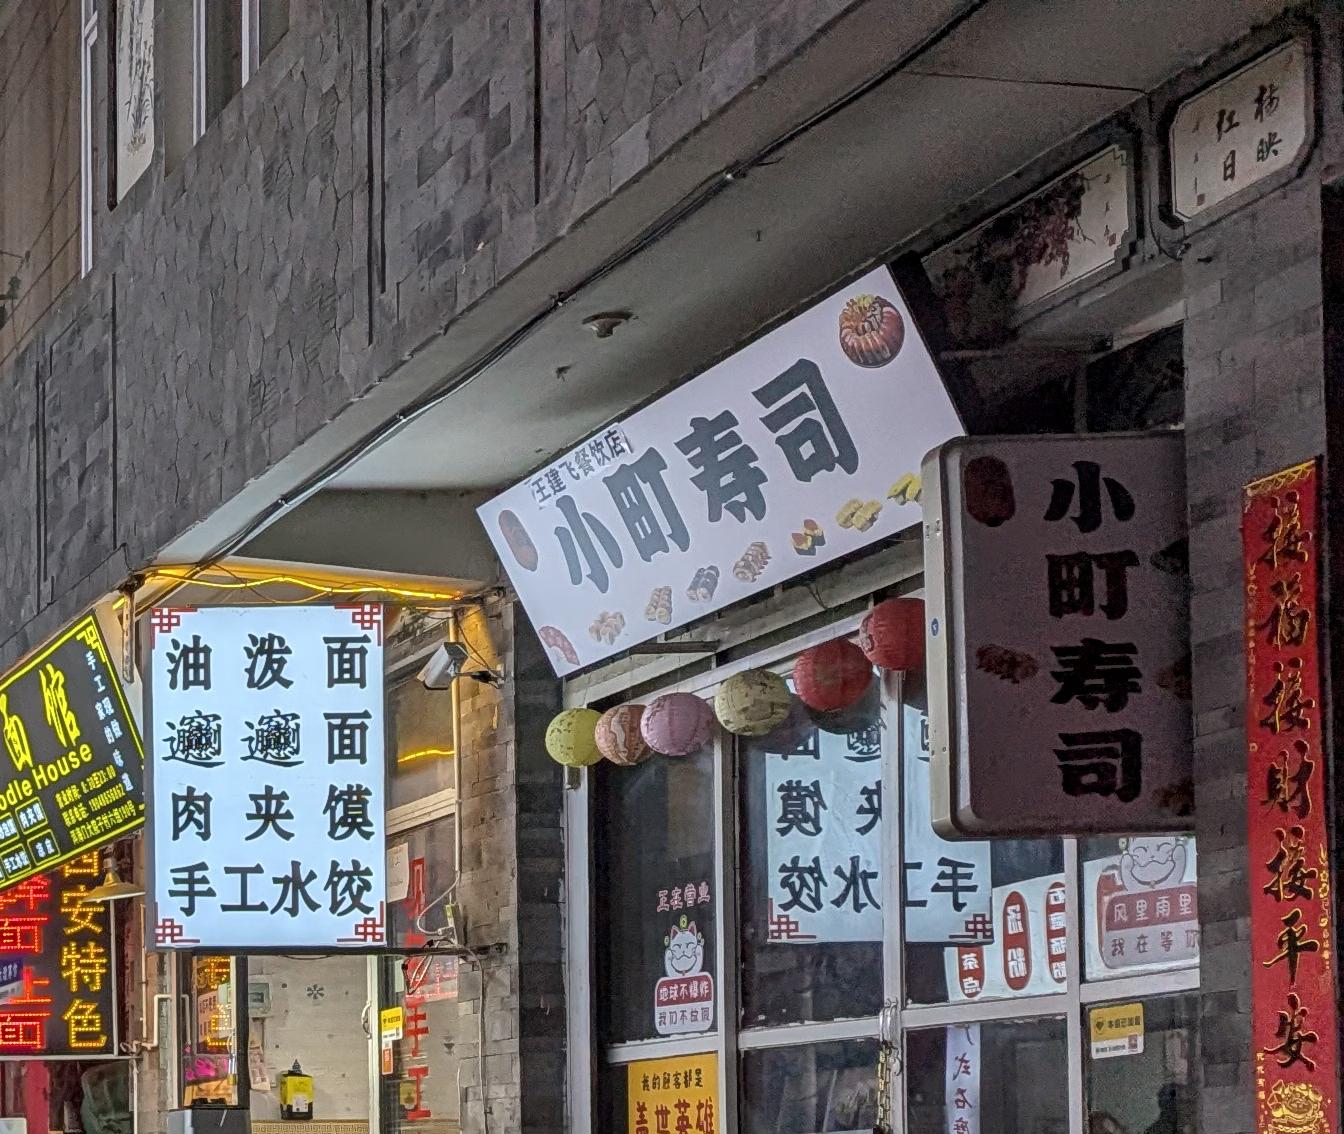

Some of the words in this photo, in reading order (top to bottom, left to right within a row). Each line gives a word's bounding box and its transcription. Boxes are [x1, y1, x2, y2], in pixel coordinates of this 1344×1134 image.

[553, 358, 858, 594] 小町寿司
[1043, 461, 1143, 802] 小町寿司
[166, 633, 372, 690] 油泼面
[32, 744, 93, 790] House
[170, 784, 375, 841] 肉夹馍
[169, 859, 374, 917] 手工水饺
[657, 881, 710, 912] 正在营业
[1114, 893, 1192, 922] 风里雨里
[61, 850, 108, 1048] 西安特色
[1112, 929, 1198, 957] 我在等你
[658, 1007, 710, 1026] 我们不放假
[659, 981, 709, 1001] 地球不爆炸
